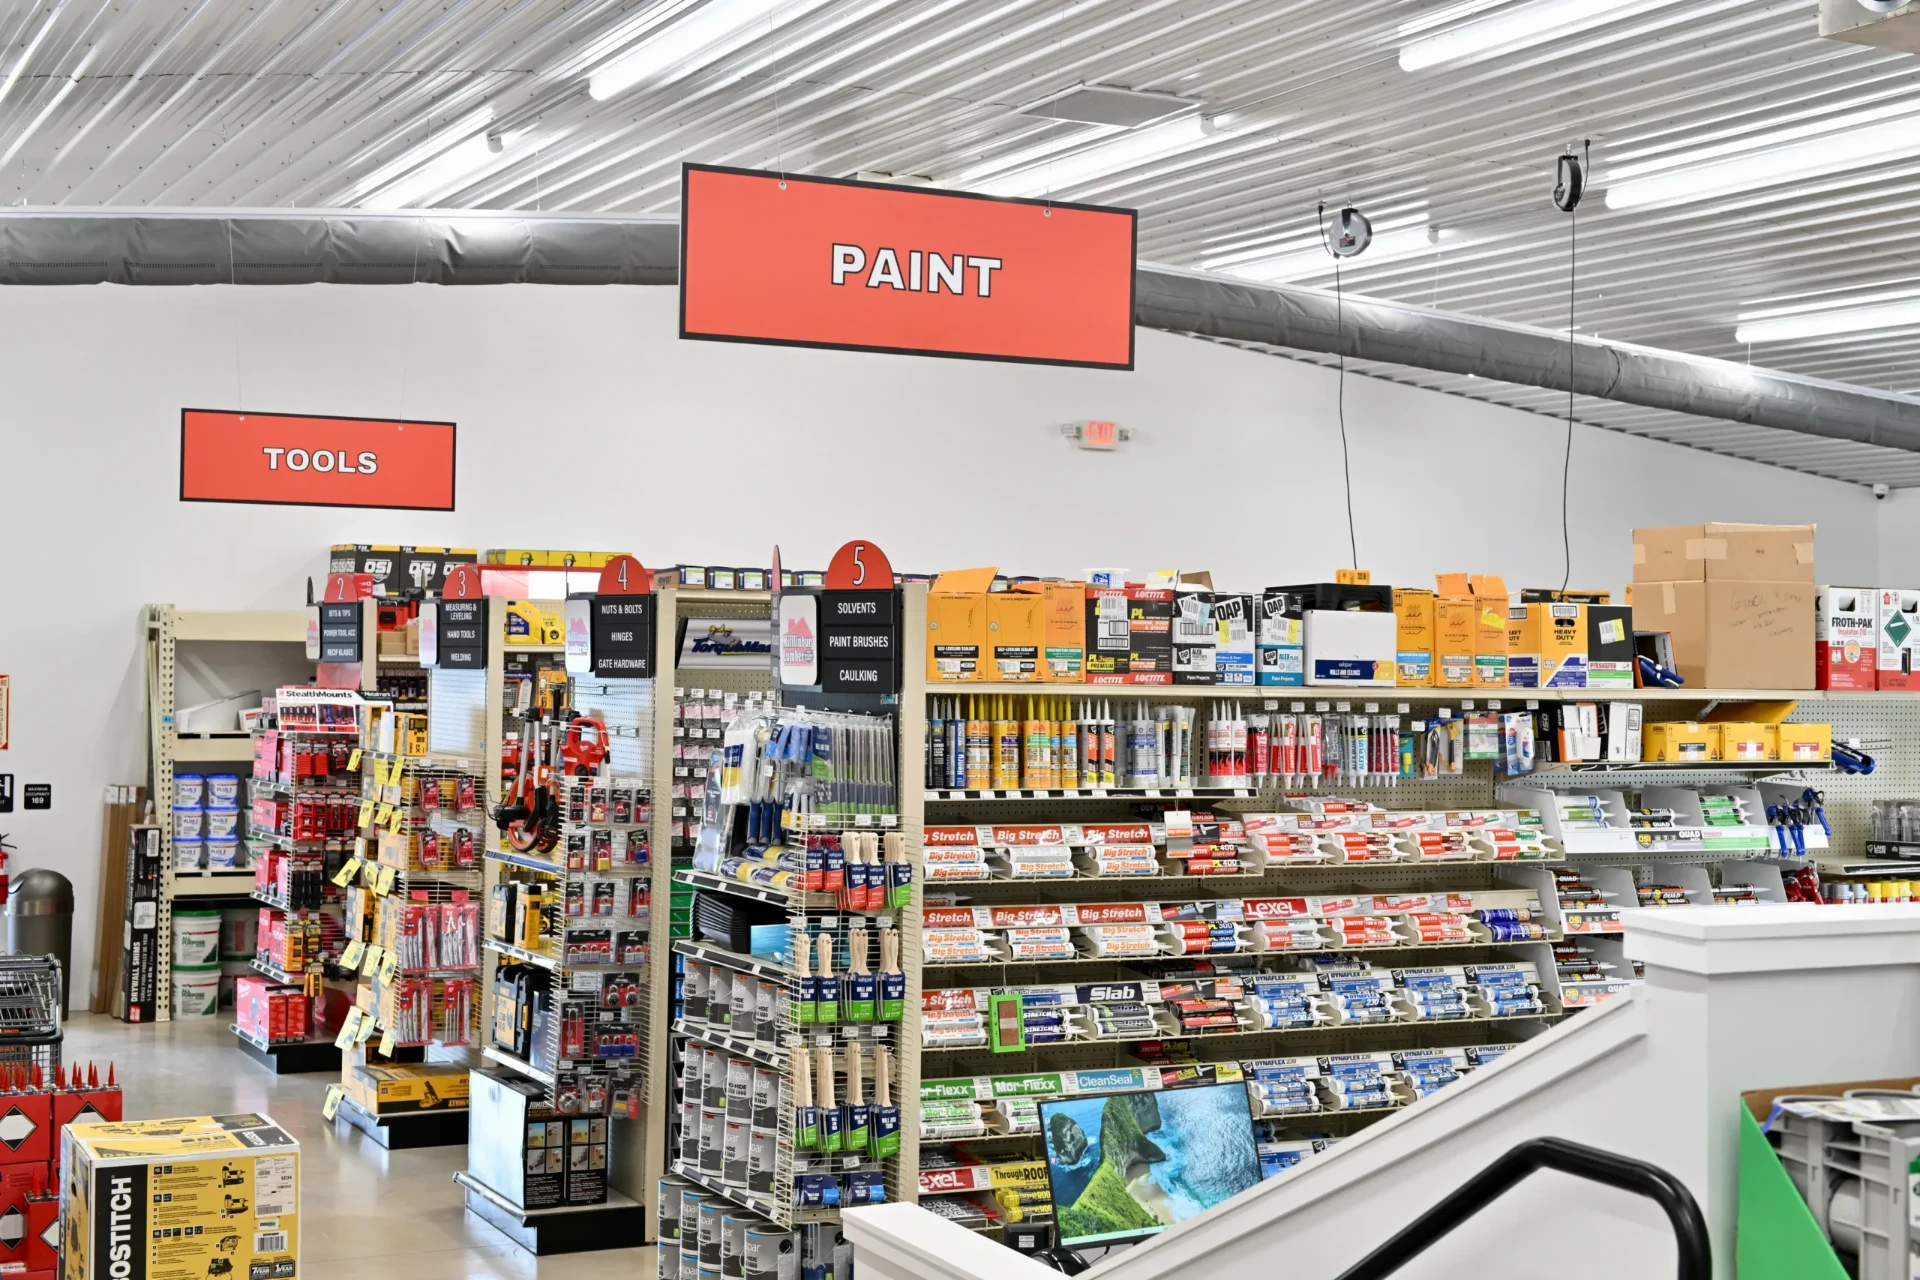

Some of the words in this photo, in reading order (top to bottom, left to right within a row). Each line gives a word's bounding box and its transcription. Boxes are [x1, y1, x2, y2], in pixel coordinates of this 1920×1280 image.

[832, 243, 1002, 298] PAINT
[1088, 421, 1114, 445] EXIT
[262, 447, 378, 475] TOOLS
[364, 561, 392, 573] OSI
[852, 546, 865, 586] 5
[618, 559, 628, 591] 4
[337, 578, 344, 600] 2
[458, 570, 466, 597] 3
[601, 605, 617, 614] NUTS
[618, 605, 623, 614] &
[624, 605, 642, 614] BOLTS
[838, 602, 876, 614] SOLVENTS
[1217, 601, 1241, 620] DAP
[1267, 599, 1283, 613] DAP
[1131, 608, 1145, 619] PL
[1832, 617, 1872, 628] FROTH-PAK
[611, 632, 633, 641] HINGES
[783, 634, 815, 650] Mifflinburg
[829, 636, 850, 648] PAINT
[853, 636, 888, 648] BRUSHES
[451, 653, 471, 661] WELDING
[783, 650, 804, 662] Lumber
[599, 660, 612, 669] GATE
[614, 660, 645, 669] HARDWARE
[840, 670, 877, 682] CAULKING
[932, 830, 974, 841] Stretch
[997, 830, 1015, 842] Big
[1017, 829, 1060, 840] Stretch
[1087, 829, 1105, 840] Big
[1107, 828, 1148, 839] Stretch
[1638, 834, 1651, 844] OSI
[1679, 830, 1700, 838] QUAD
[928, 852, 943, 860] Big
[944, 852, 976, 860] Stretch
[1103, 849, 1118, 857] Big
[1118, 847, 1148, 857] Stretch
[1020, 863, 1034, 872] Big
[929, 912, 970, 923] Stretch
[996, 912, 1014, 922] Big
[1082, 909, 1099, 920] Big
[1102, 908, 1142, 917] Stretch
[1569, 916, 1581, 924] OSI
[131, 968, 140, 1002] DRYWALL
[1090, 986, 1134, 1000] Slab
[996, 1081, 1056, 1091] Mor-Flexx
[1079, 1076, 1133, 1087] CleanSeal
[920, 1084, 968, 1095] or-Flexx
[242, 1131, 266, 1146] BOSTITCH
[995, 1169, 1023, 1180] Through
[110, 1178, 131, 1280] OSTITCH
